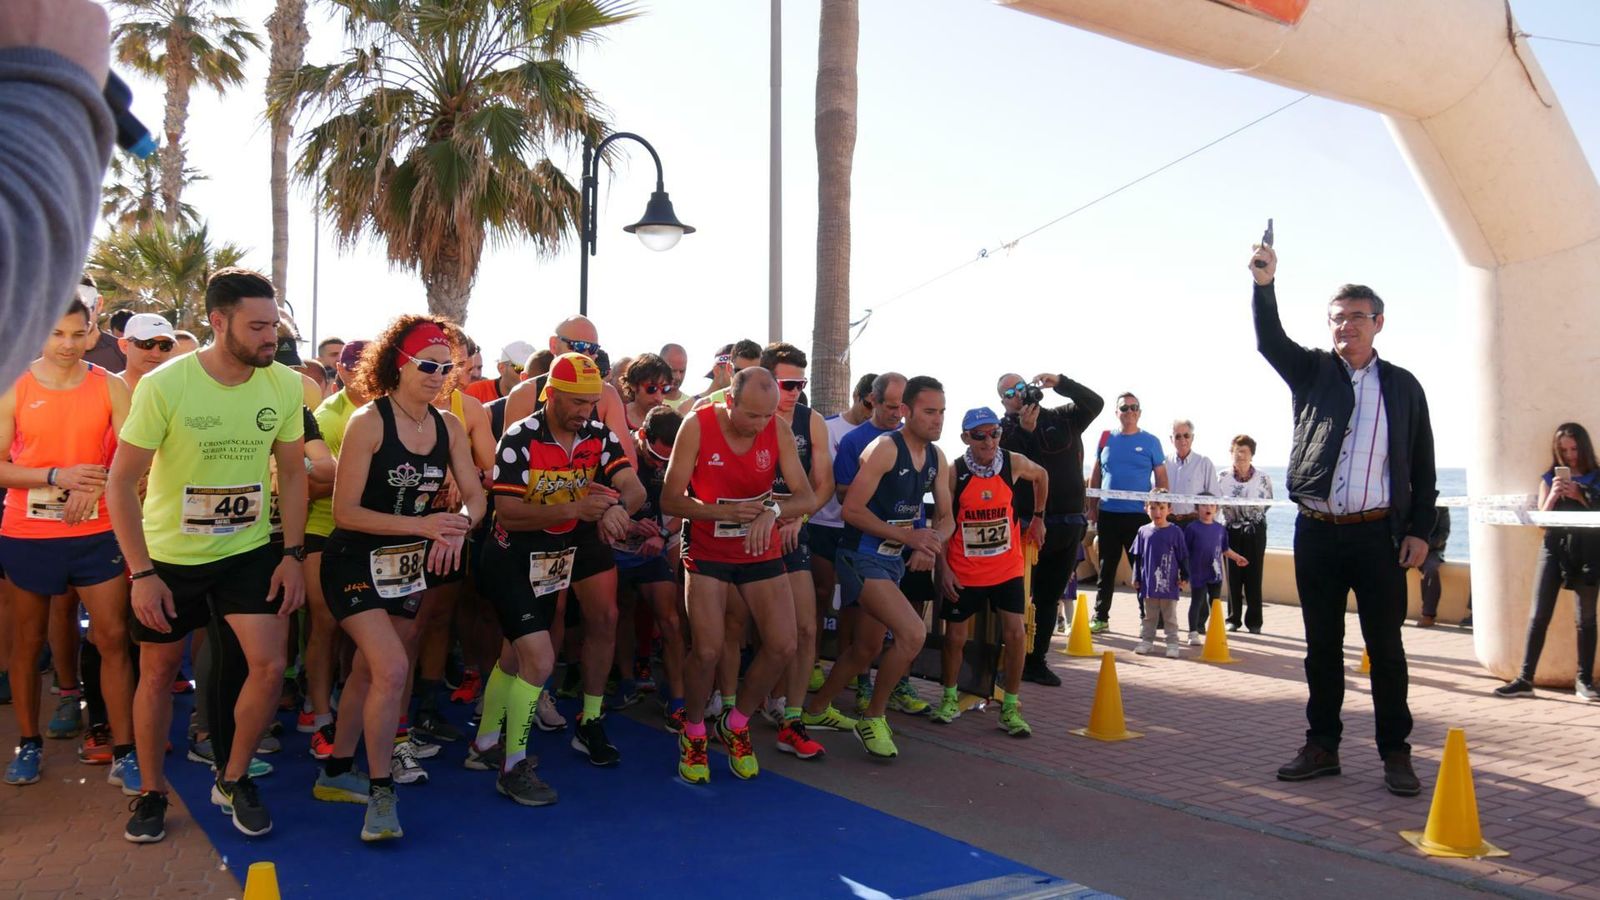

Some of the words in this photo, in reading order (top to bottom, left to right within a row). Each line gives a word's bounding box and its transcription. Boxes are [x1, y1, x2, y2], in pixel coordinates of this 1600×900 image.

[214, 496, 249, 517] 40
[964, 508, 1007, 520] ALMERIA
[977, 525, 1006, 543] 127
[399, 553, 419, 576] 88
[548, 557, 565, 576] 49
